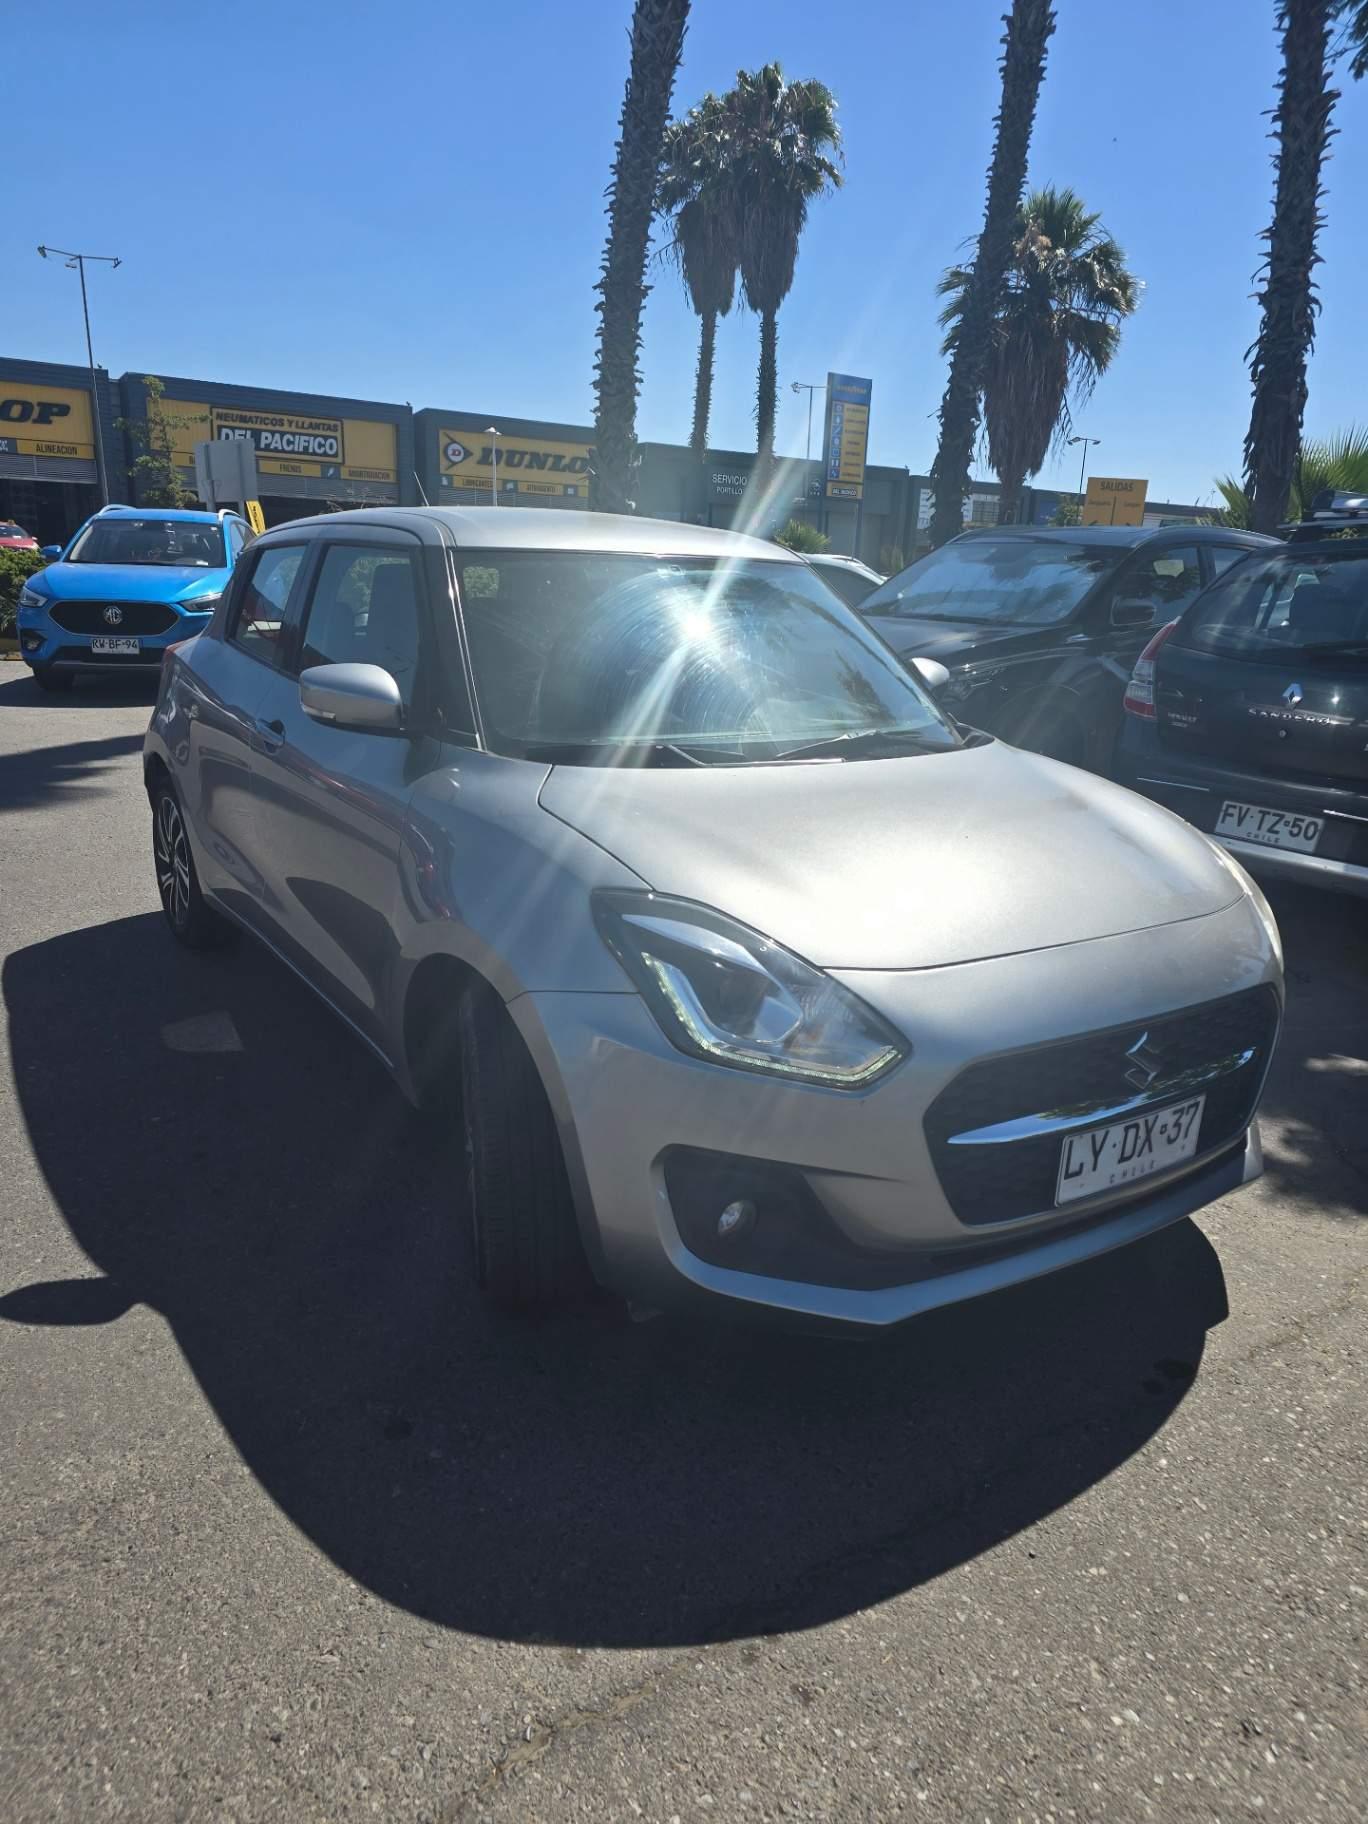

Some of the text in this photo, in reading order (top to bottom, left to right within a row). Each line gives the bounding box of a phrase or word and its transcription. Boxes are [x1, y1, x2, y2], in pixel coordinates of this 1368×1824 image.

[216, 412, 339, 433] NEUMATICOS Y LLANTAS
[36, 443, 78, 456] ALINEACION
[260, 432, 338, 455] PACIFICO
[477, 447, 590, 474] DUNLO
[712, 473, 748, 486] SERVICIO
[716, 486, 743, 495] PORTILLO
[1100, 481, 1134, 492] SALIDAS
[1246, 832, 1281, 844] CHILE
